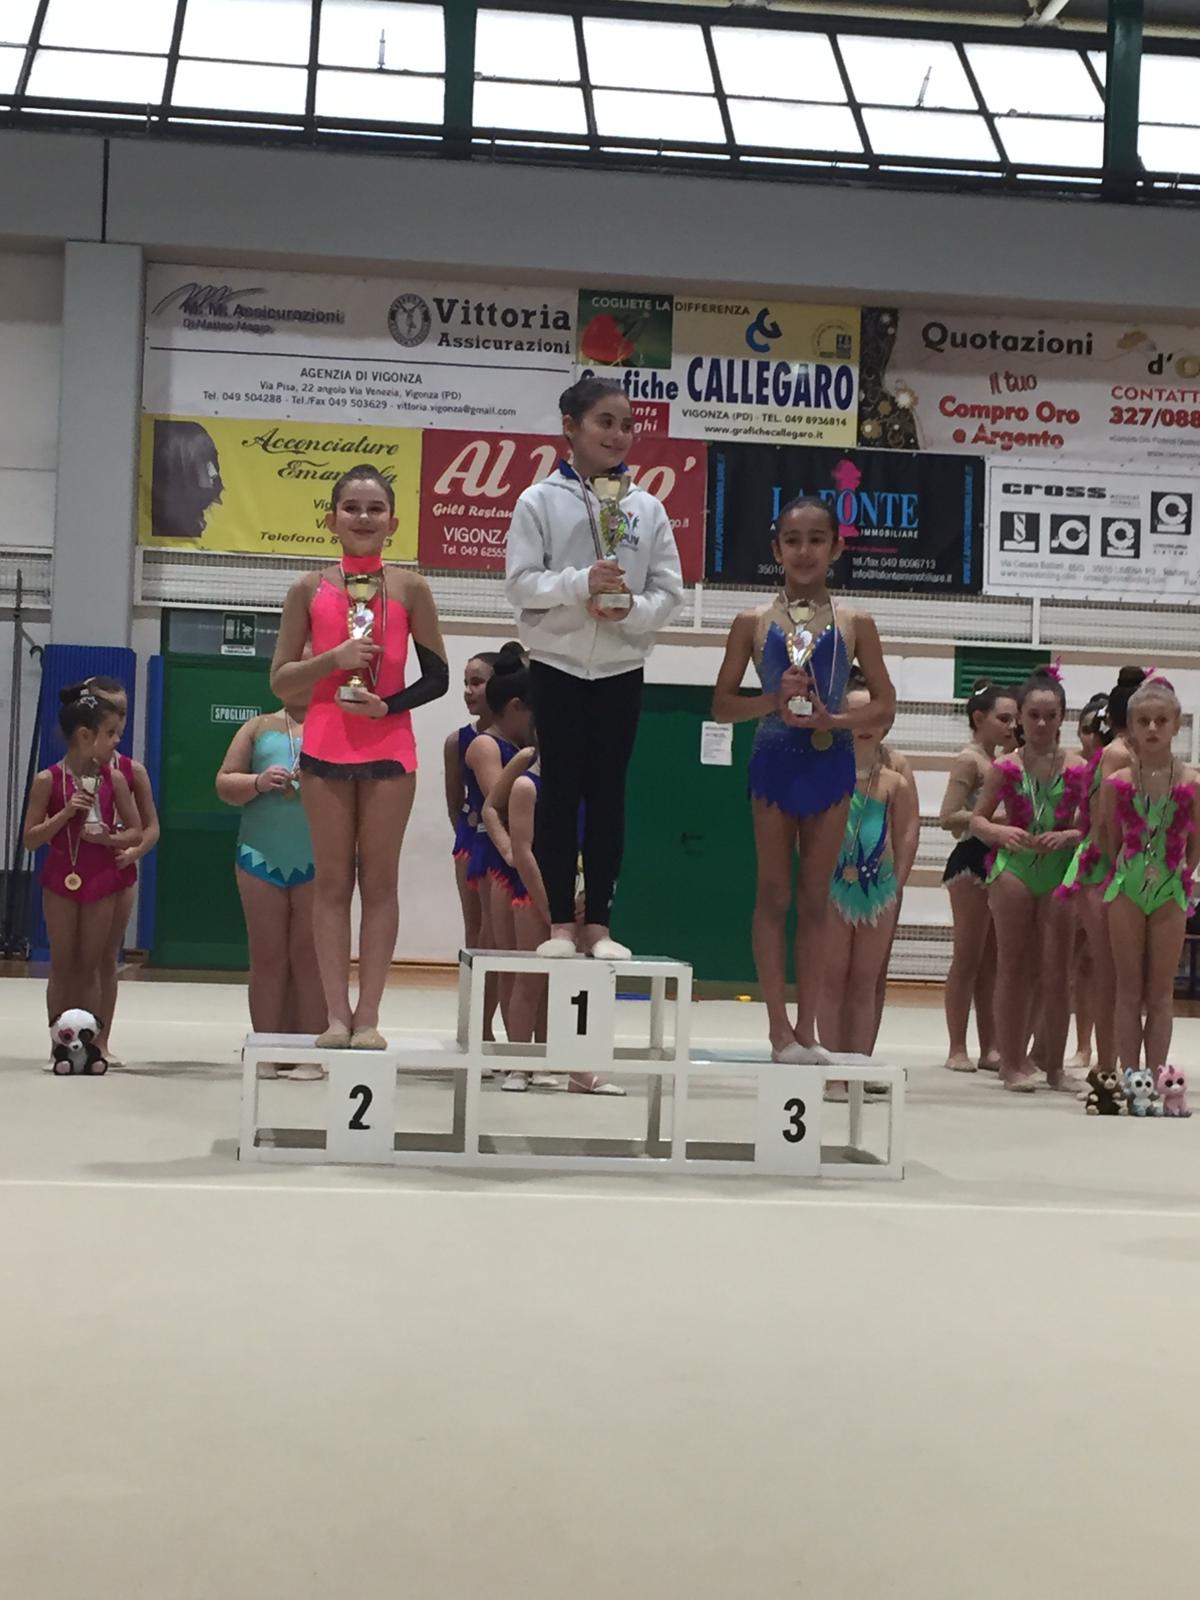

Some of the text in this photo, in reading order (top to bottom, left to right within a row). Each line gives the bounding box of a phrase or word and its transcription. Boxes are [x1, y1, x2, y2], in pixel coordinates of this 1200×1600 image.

[233, 304, 344, 324] Assicurazioni
[433, 297, 571, 331] Vittoria
[592, 297, 750, 315] COGLIETE LA DIFFERENZA
[437, 333, 571, 354] Assicurazioni
[921, 322, 1093, 355] Quotazioni
[300, 367, 423, 384] AGENZIA DI VIGONZA
[581, 357, 853, 410] fiche CALLEGARO
[1004, 371, 1037, 391] tuo
[204, 391, 220, 401] Tel.
[222, 392, 241, 401] 049
[244, 393, 282, 404] 504288
[328, 398, 347, 408] 049
[350, 399, 388, 410] 503629
[260, 381, 274, 391] Via
[302, 384, 314, 393] 22
[317, 385, 346, 396] angolo
[349, 386, 363, 396] Via
[405, 389, 439, 401] Vigonza
[441, 391, 462, 401] (PD)
[1111, 385, 1200, 403] CONTATT
[682, 409, 730, 420] VIGONZA
[732, 411, 753, 421] (PD)
[762, 413, 782, 423] TEL.
[785, 414, 803, 424] 049
[939, 395, 1080, 424] Compro Oro
[953, 424, 1064, 450] e Argento
[433, 439, 516, 498] Al
[1002, 483, 1106, 499] cross
[432, 503, 465, 516] Grill
[260, 532, 325, 543] Telefono
[860, 530, 919, 540] IMMOBILIARE
[570, 990, 588, 1036] 1
[348, 1085, 373, 1130] 2
[782, 1098, 806, 1143] 3
